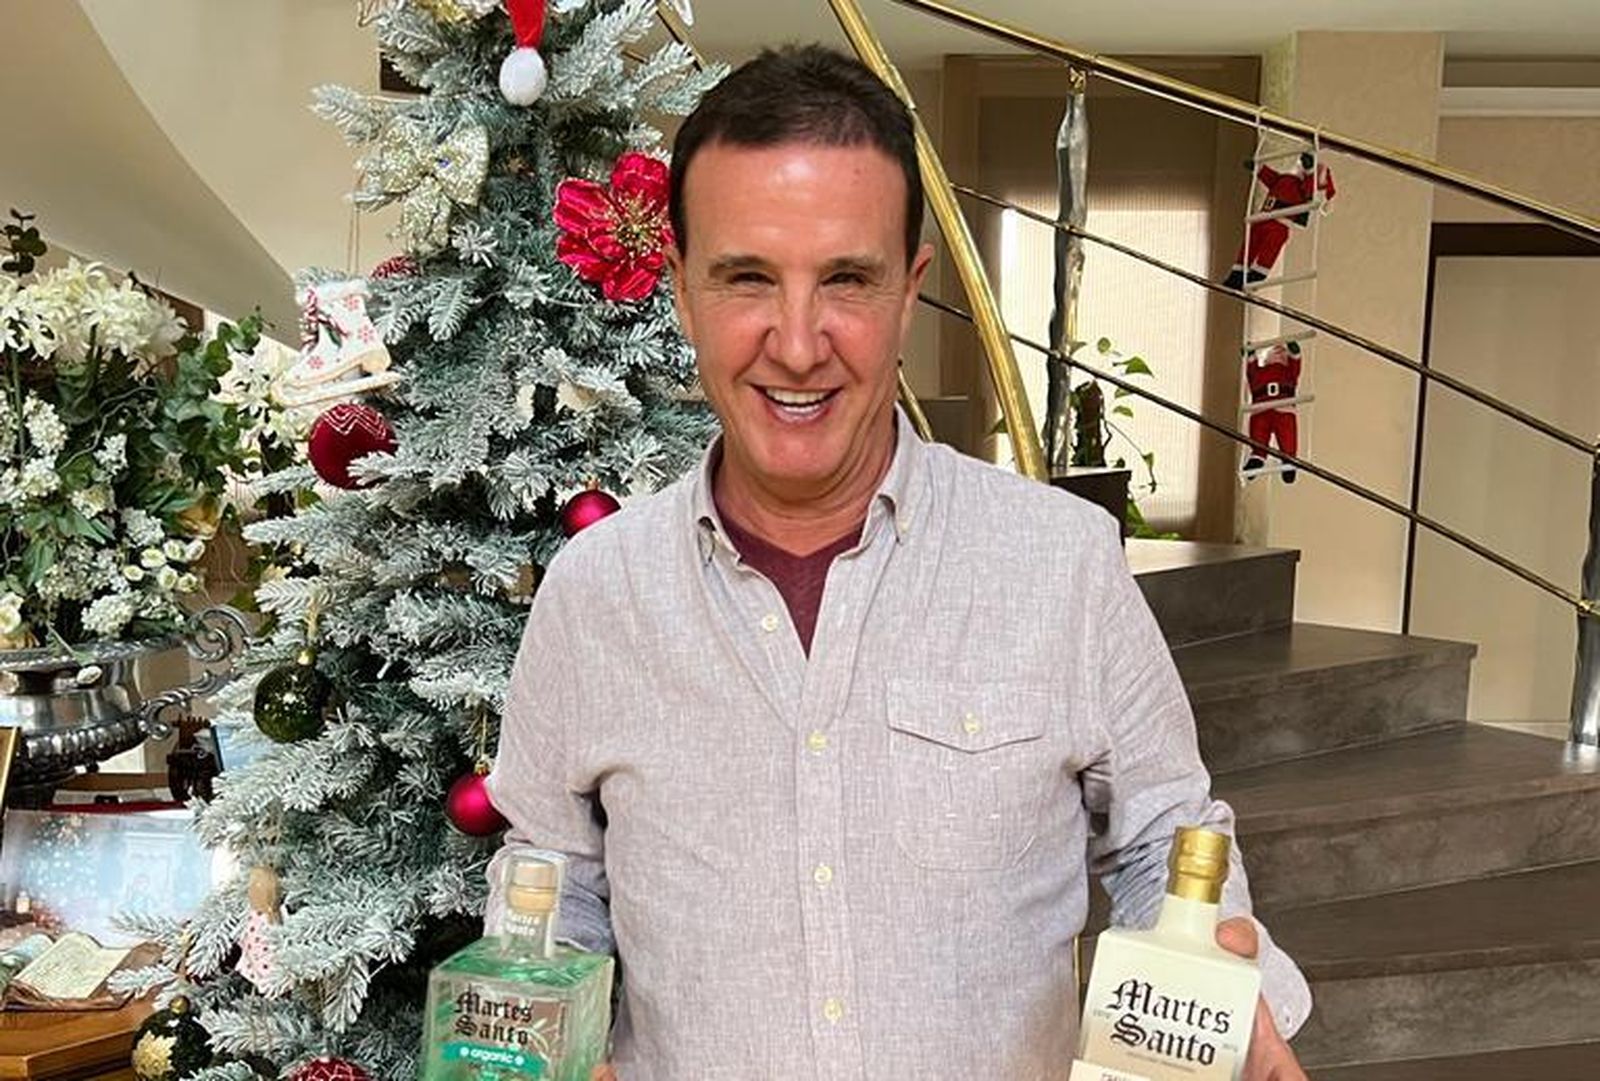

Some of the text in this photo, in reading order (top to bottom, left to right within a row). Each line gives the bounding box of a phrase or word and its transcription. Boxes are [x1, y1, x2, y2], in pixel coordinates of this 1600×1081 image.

[454, 985, 533, 1023] Martes
[1107, 979, 1232, 1034] Martes
[454, 1015, 529, 1046] Santo
[1111, 1013, 1216, 1066] Santo
